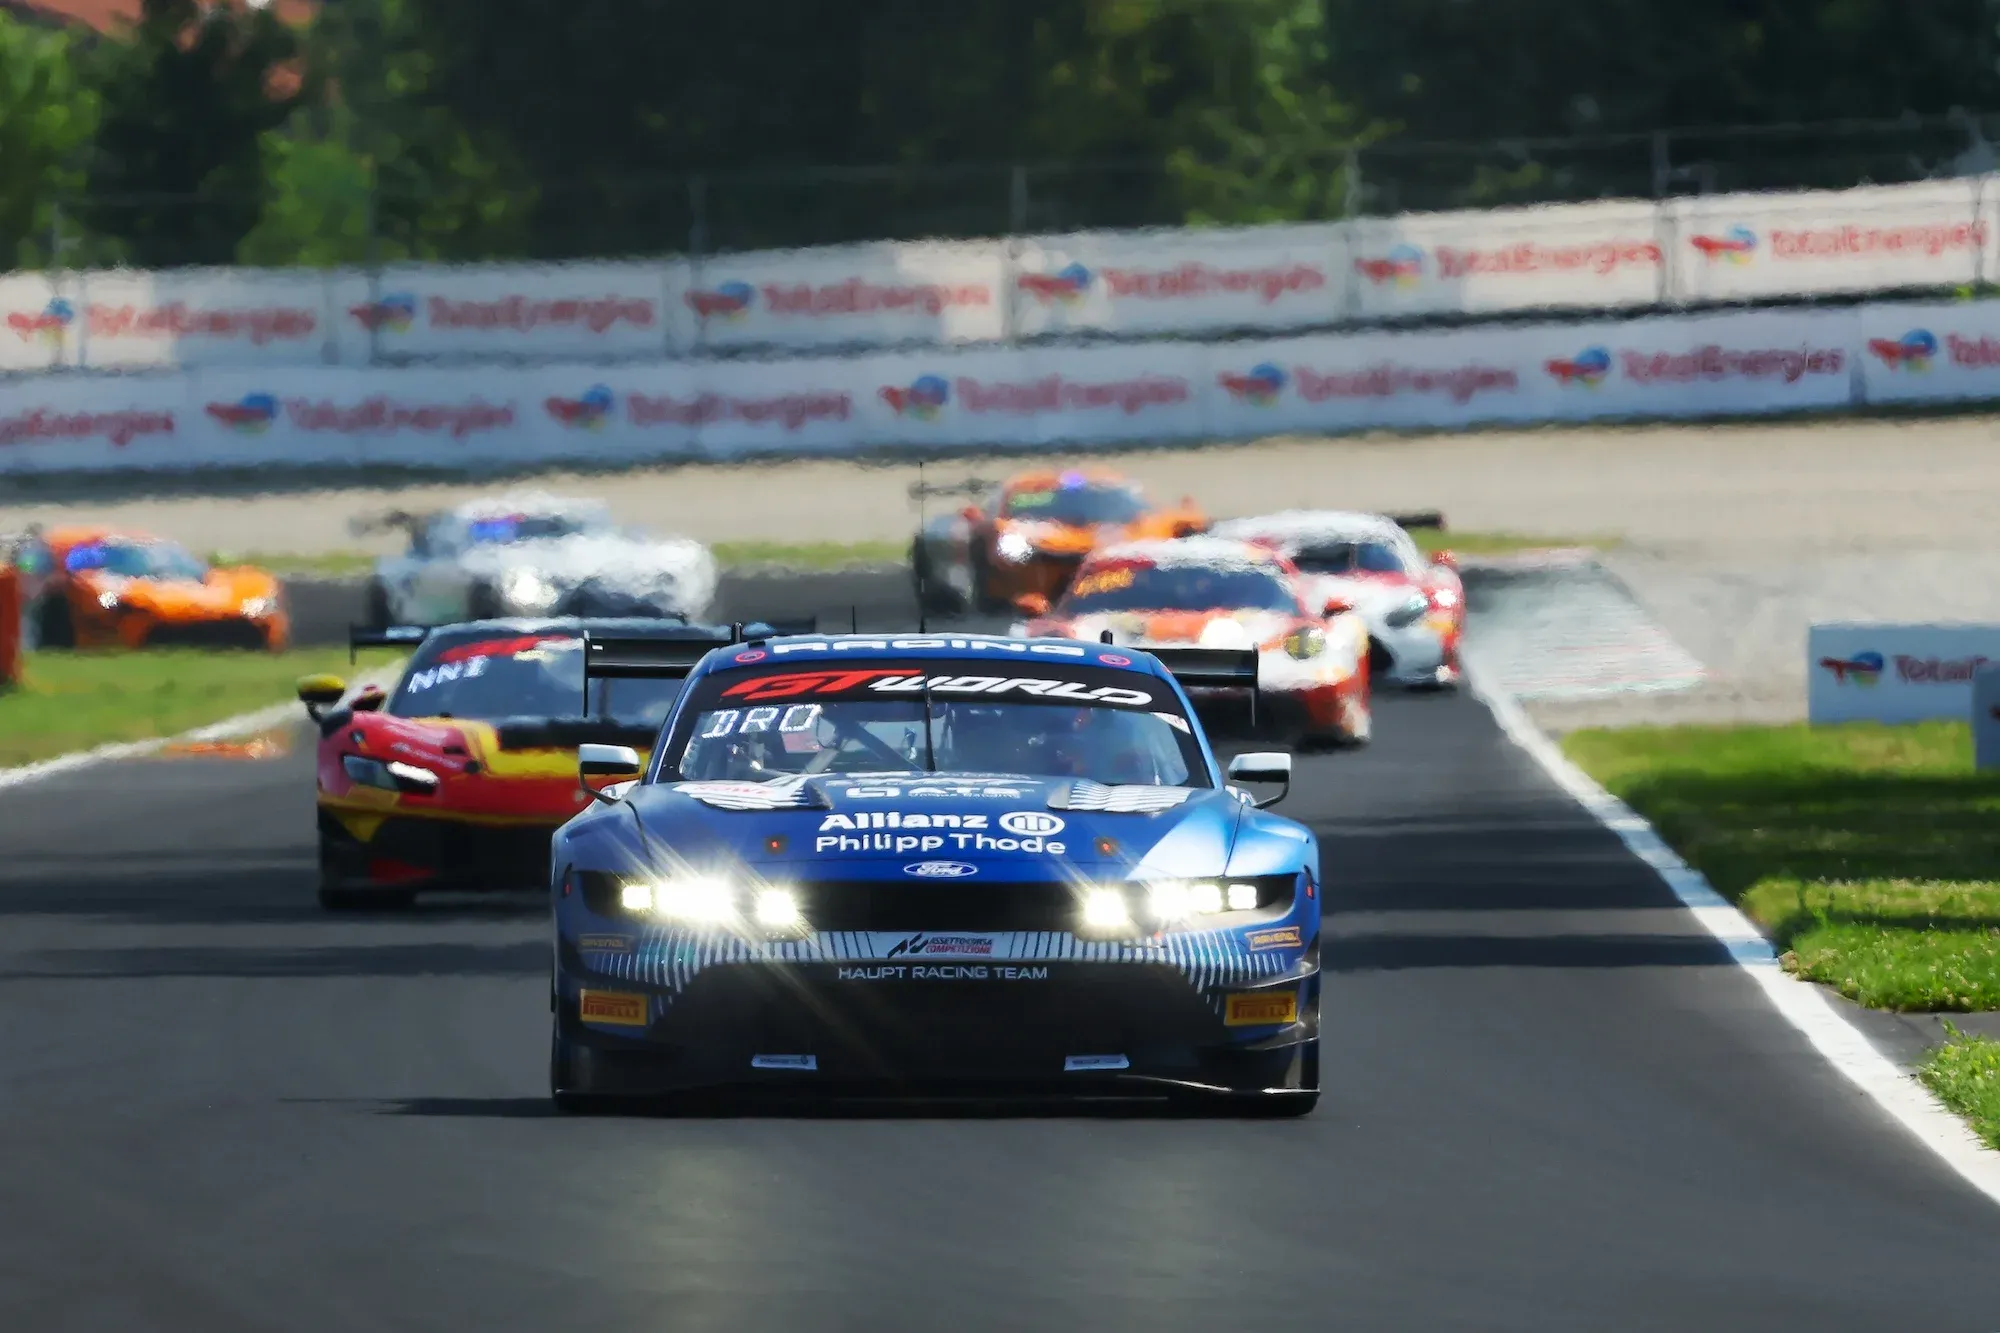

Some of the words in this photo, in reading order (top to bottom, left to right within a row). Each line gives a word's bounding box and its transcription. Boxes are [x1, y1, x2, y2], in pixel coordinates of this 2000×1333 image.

[720, 669, 925, 700] GT
[868, 675, 1152, 705] WORLD
[819, 812, 988, 831] Allianz
[816, 833, 944, 853] Philipp
[949, 833, 1066, 855] Thode
[916, 862, 965, 876] Ford
[838, 966, 907, 980] HAUPT
[912, 966, 988, 979] RACING
[994, 966, 1048, 979] TEAM
